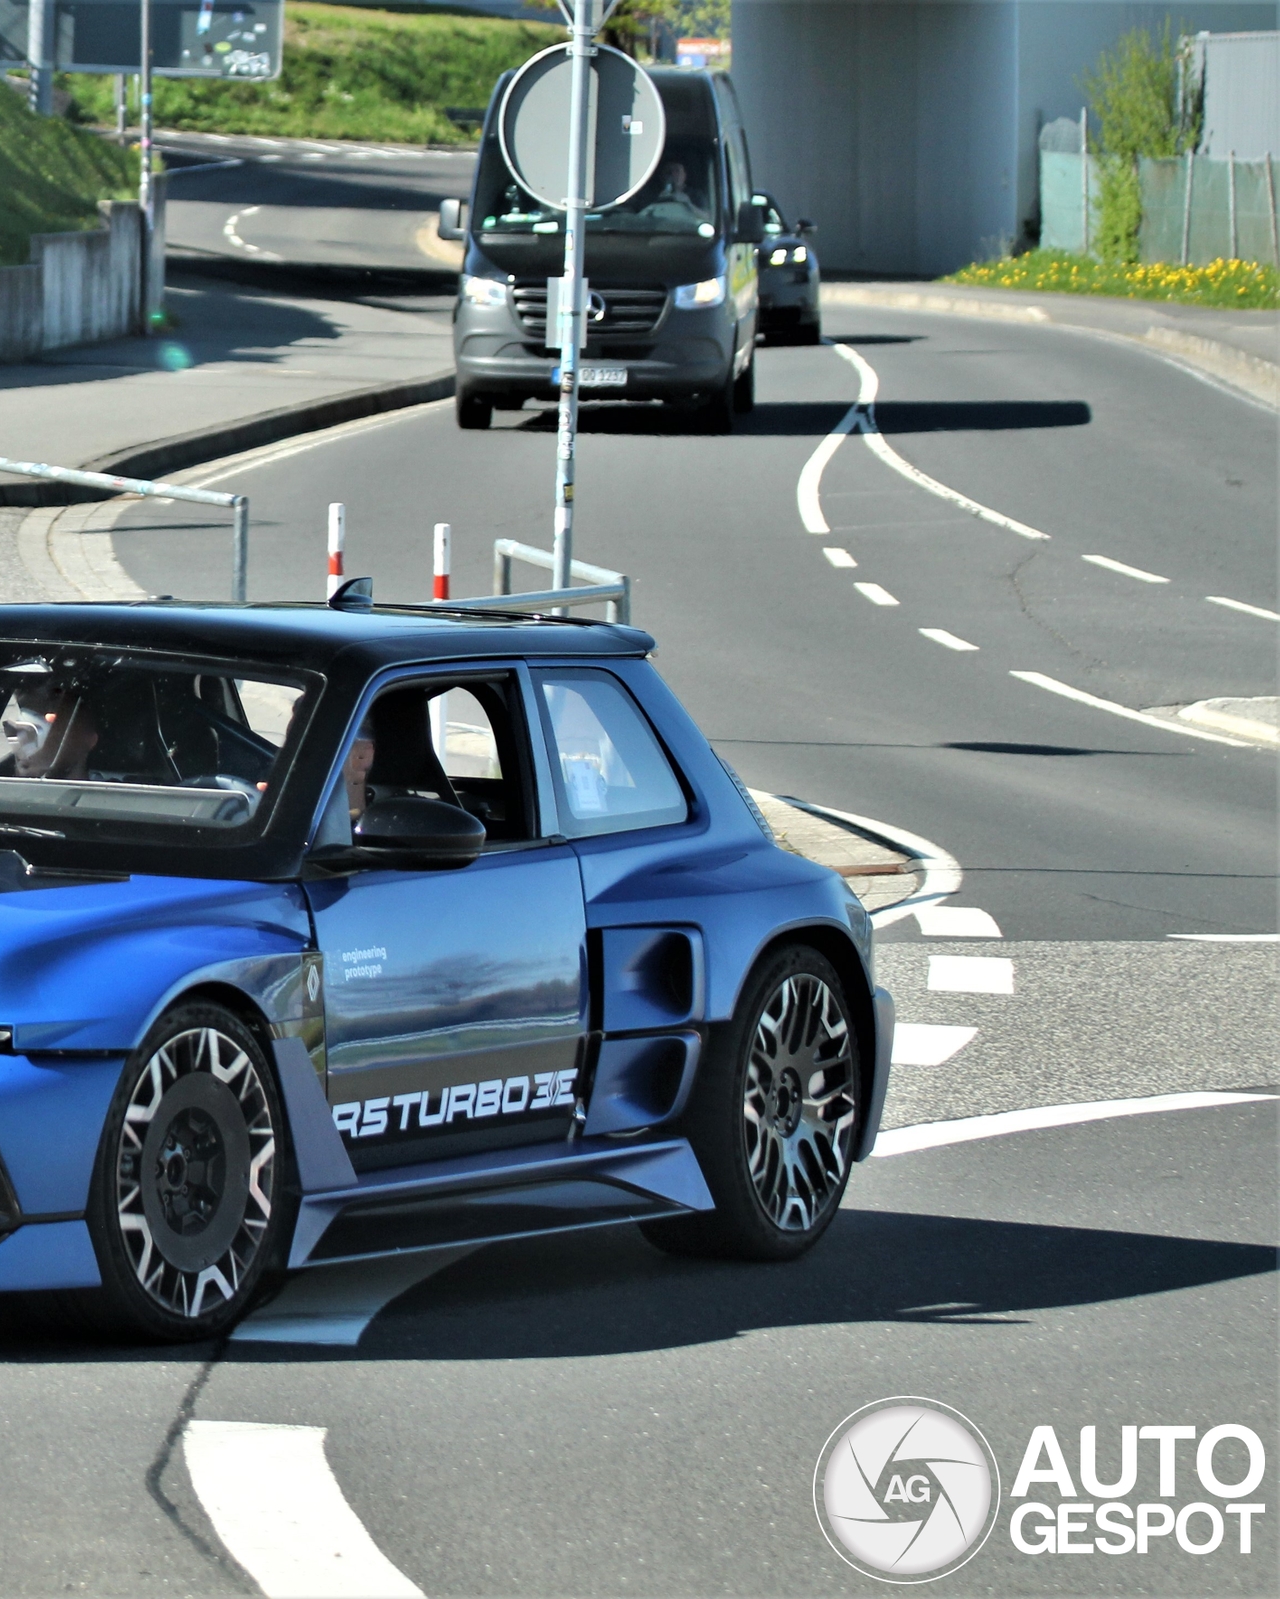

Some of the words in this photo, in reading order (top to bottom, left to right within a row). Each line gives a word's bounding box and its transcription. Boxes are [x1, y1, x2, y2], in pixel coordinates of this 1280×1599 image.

[342, 945, 388, 964] engineering
[344, 963, 383, 982] prototype
[392, 1075, 530, 1131] TURBO
